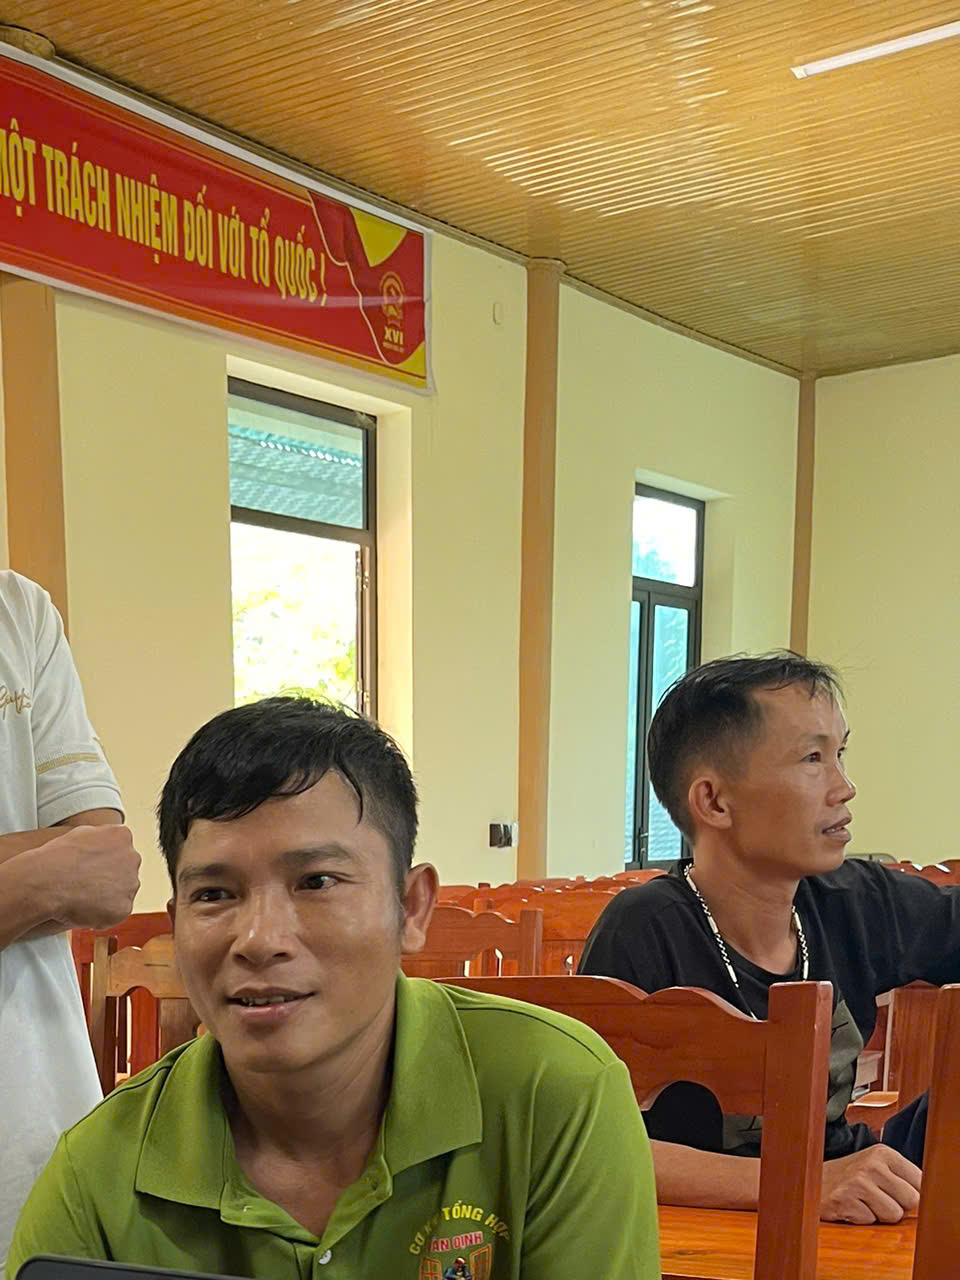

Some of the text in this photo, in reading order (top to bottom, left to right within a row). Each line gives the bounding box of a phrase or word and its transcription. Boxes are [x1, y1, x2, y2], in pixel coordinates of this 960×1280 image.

[41, 141, 112, 233] TRÁCH
[115, 173, 179, 265] NHIỆM
[183, 184, 214, 270] ĐỐI
[217, 204, 247, 281] VỚI
[249, 207, 271, 289] TỔ
[274, 224, 319, 303] QUỐC
[383, 326, 404, 345] XVI
